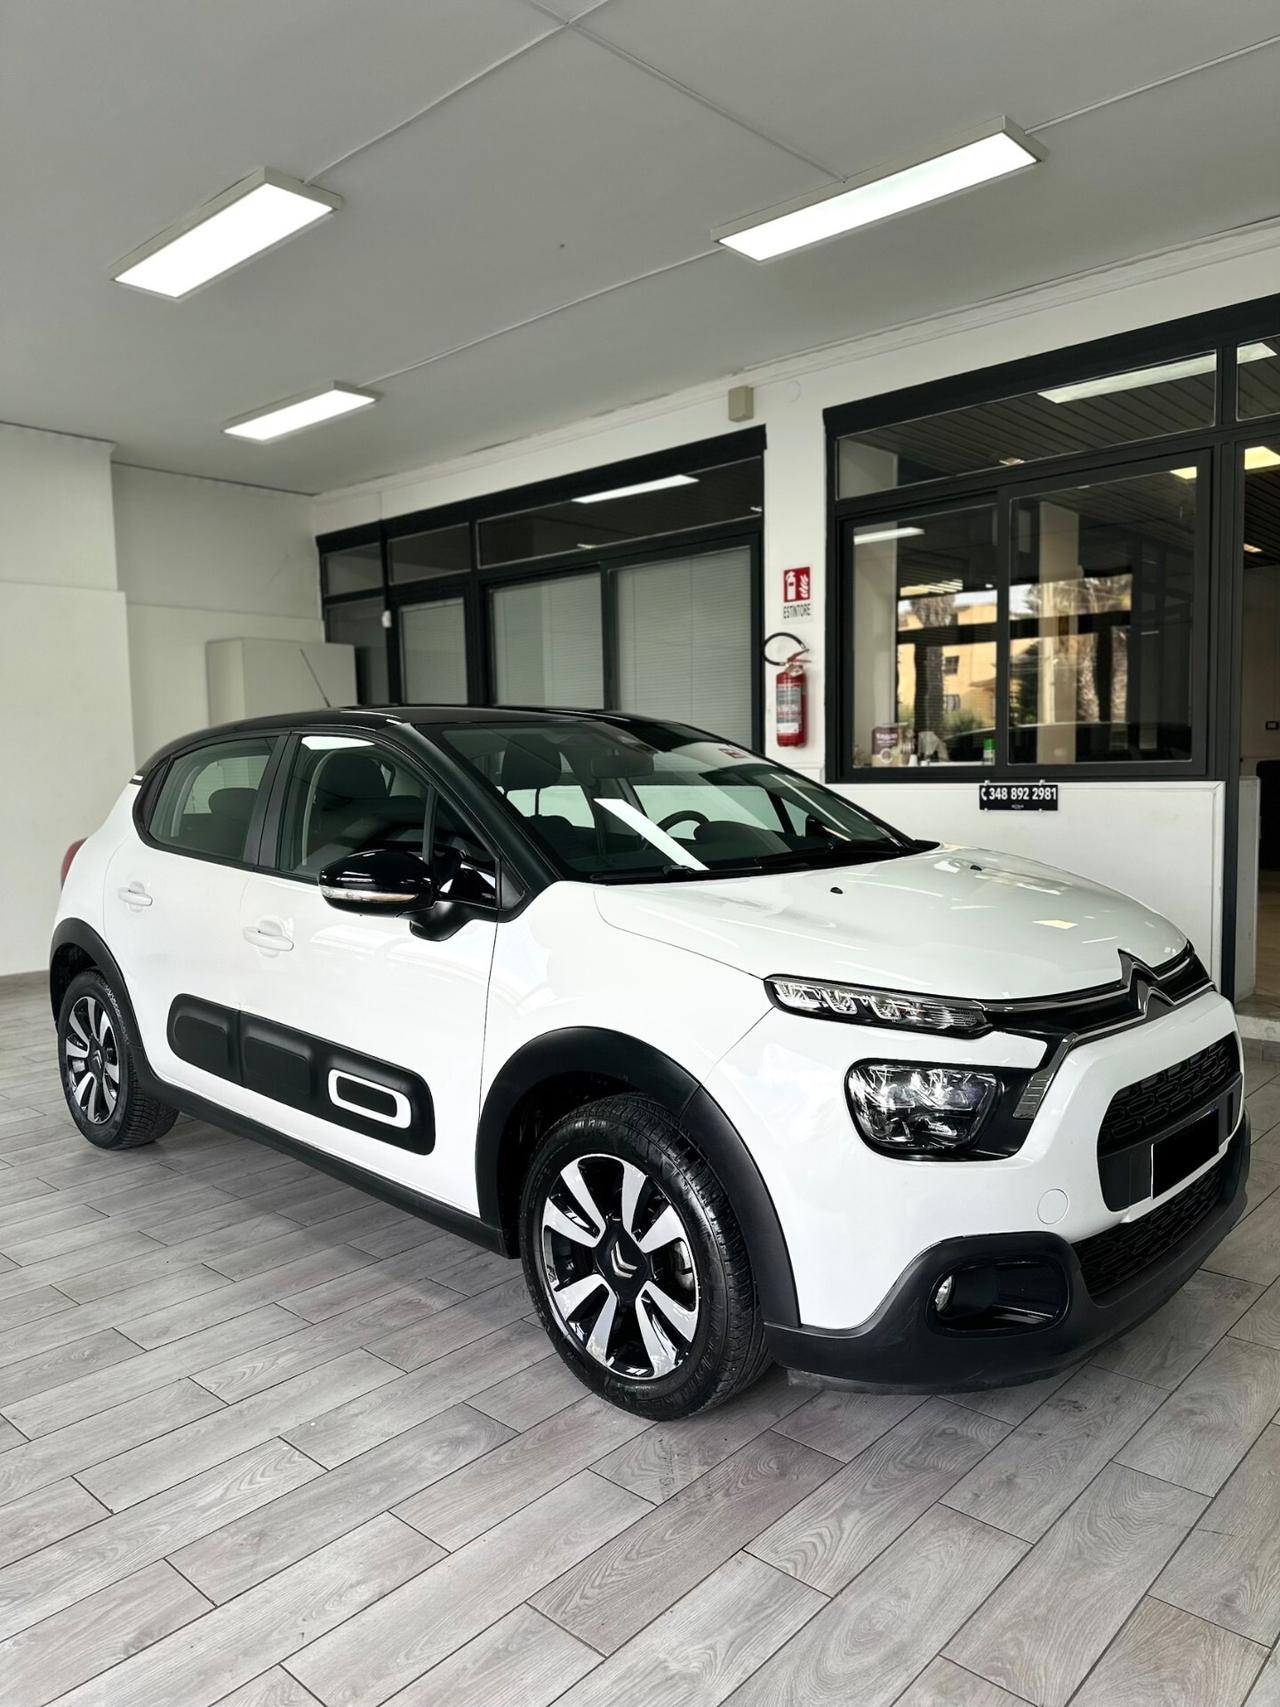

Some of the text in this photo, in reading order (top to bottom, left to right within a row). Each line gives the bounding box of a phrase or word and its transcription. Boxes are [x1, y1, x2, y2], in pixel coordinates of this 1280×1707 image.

[783, 603, 811, 619] ESTINTORE
[989, 787, 1056, 800] 348 892 2981
